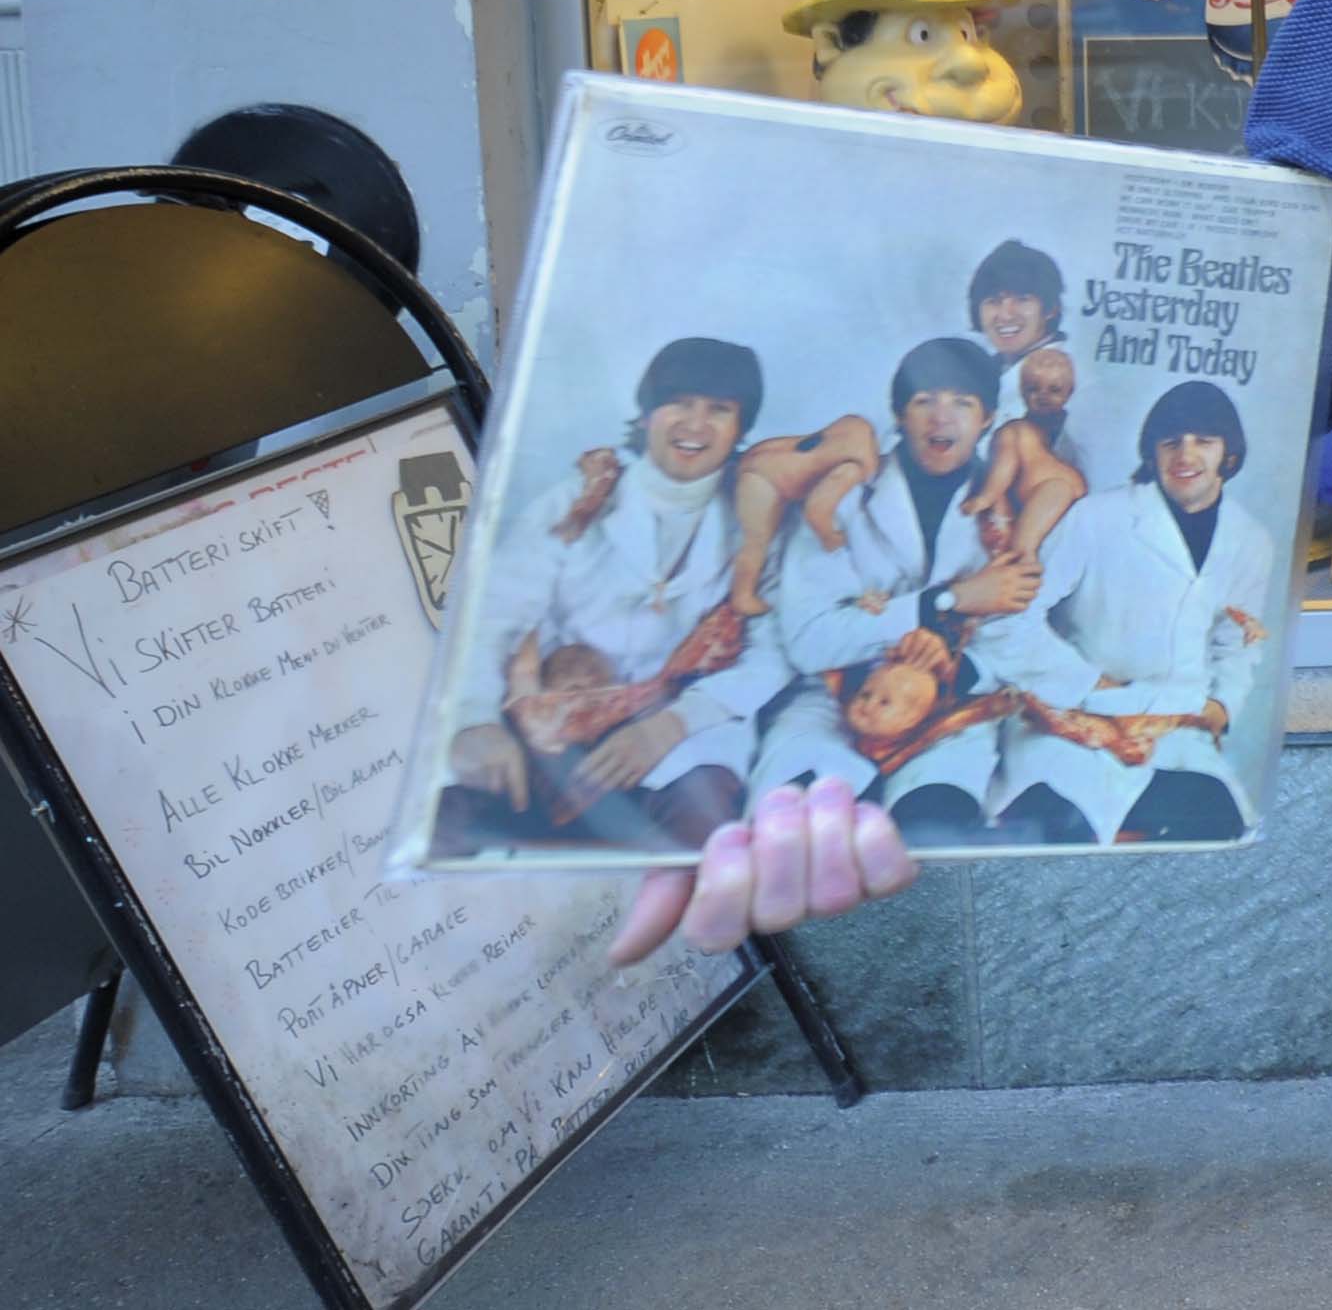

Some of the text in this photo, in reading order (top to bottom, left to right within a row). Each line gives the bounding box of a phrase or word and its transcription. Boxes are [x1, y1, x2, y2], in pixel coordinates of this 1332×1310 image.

[1113, 242, 1292, 295] The Beatles
[1081, 279, 1240, 336] Yesterday
[1095, 325, 1257, 386] And Today
[157, 783, 224, 834] ALLE
[223, 743, 305, 792] KLOKKE
[218, 896, 272, 936] KODE
[547, 1053, 596, 1099] KAN
